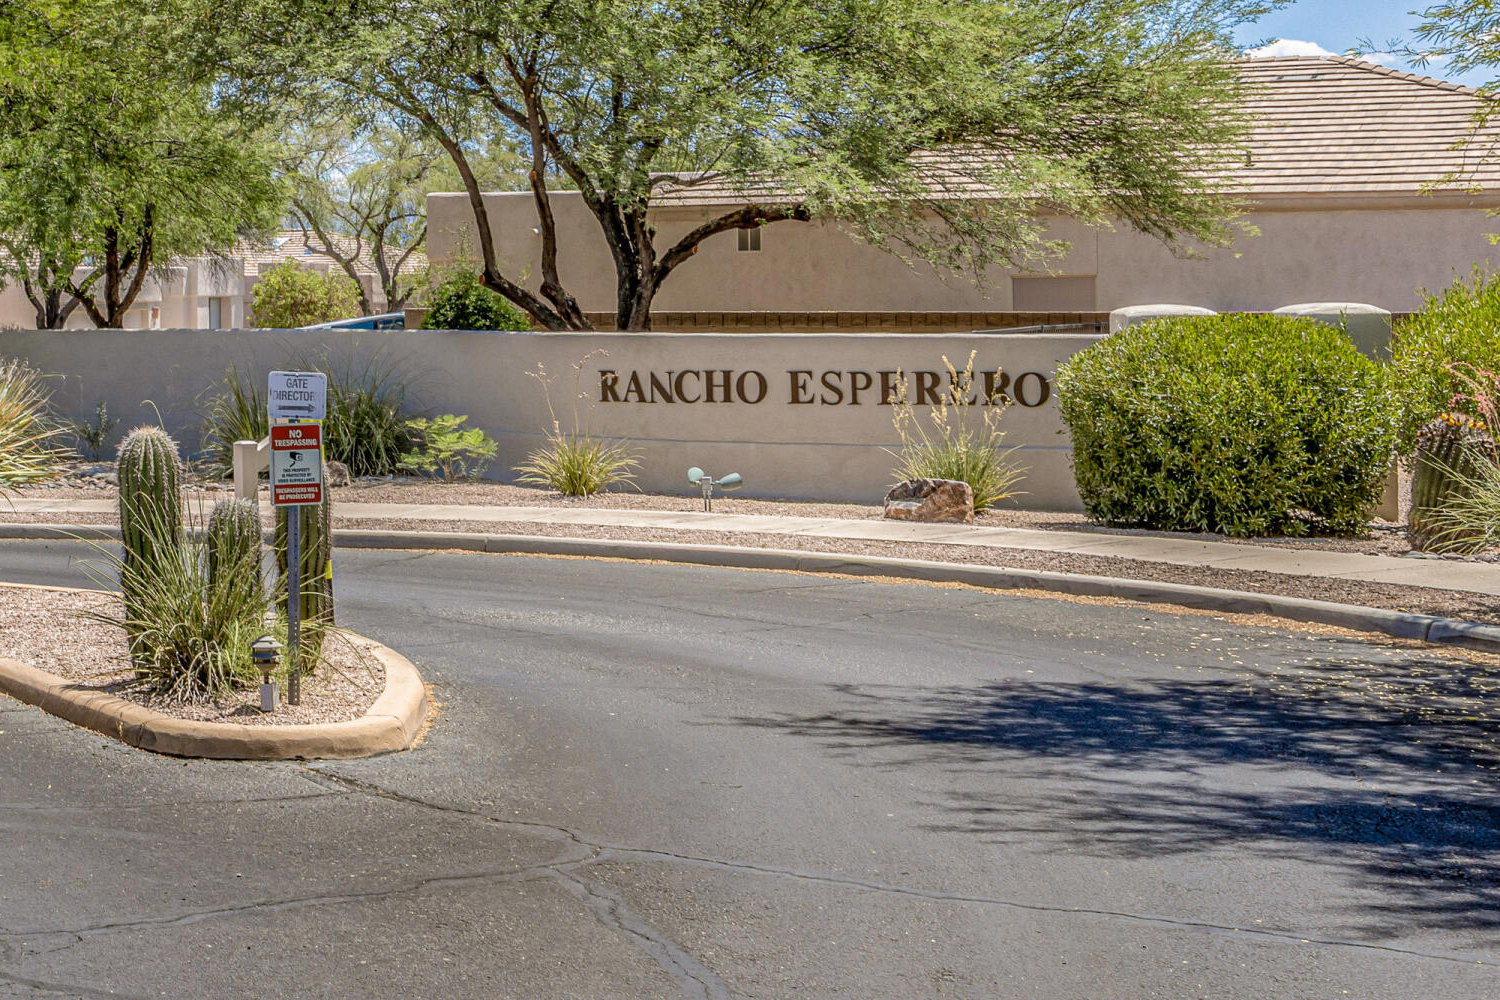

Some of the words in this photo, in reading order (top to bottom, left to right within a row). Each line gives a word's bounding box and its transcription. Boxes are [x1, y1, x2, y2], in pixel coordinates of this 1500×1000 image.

[286, 378, 308, 389] GATE
[598, 369, 768, 405] RANCHO
[786, 369, 1051, 408] ESPERERO
[289, 430, 302, 438] NO
[274, 439, 317, 447] TRESPASSING
